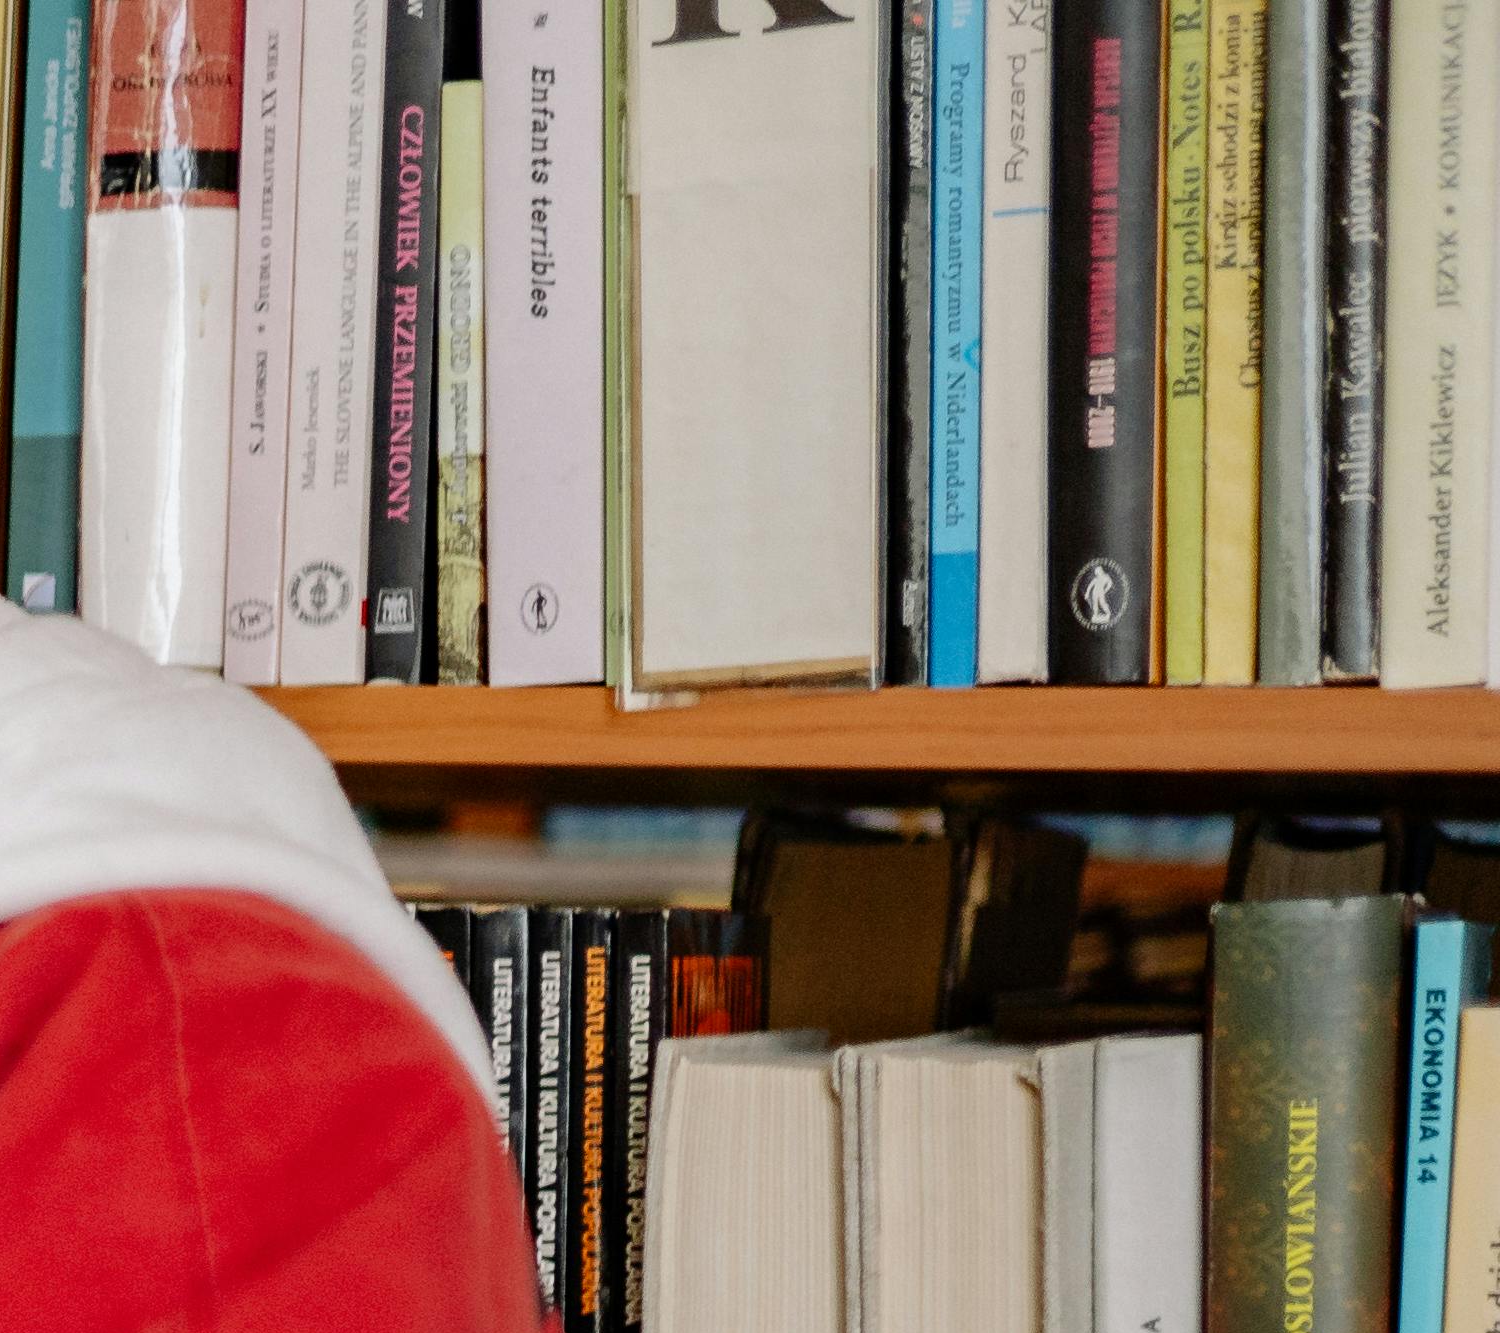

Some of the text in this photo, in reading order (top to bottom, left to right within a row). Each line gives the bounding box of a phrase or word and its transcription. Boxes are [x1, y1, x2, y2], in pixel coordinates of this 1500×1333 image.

[350, 56, 368, 98] AND
[1216, 14, 1239, 80] konia
[347, 104, 366, 171] ALPINE
[1004, 53, 1029, 183] Ryszard
[1171, 61, 1201, 151] Notes
[1216, 100, 1238, 193] schodzi
[345, 176, 363, 213] THE
[345, 220, 361, 241] IN
[530, 67, 556, 320] Enfants terribles
[1342, 109, 1380, 243] pierwszy
[1171, 166, 1206, 400] Busz po polsku
[1213, 197, 1239, 269] Kirgiz
[339, 248, 361, 352] LANGUAGE
[387, 105, 424, 525] CZŁOWIEK PRZEMIENIONY
[941, 62, 971, 529] Programy romantyzmu w Niderlandach
[1340, 270, 1372, 399] Kawalec
[335, 356, 358, 446] SLOVENE
[1340, 410, 1376, 503] Julian
[1428, 344, 1457, 480] Kiklewicz
[333, 450, 351, 489] THE
[1426, 487, 1454, 638] Aleksander
[491, 957, 513, 1080] LITERATURA
[539, 950, 562, 1075] LITERATURA
[540, 1077, 559, 1086] I
[581, 945, 607, 1315] LITERATURA I KULTURA POPULARNA
[1416, 989, 1447, 1185] EKONOMIA 14
[537, 1089, 559, 1188] KULTURA
[624, 954, 652, 1326] LITERATURA I KULTURA POPULARNA
